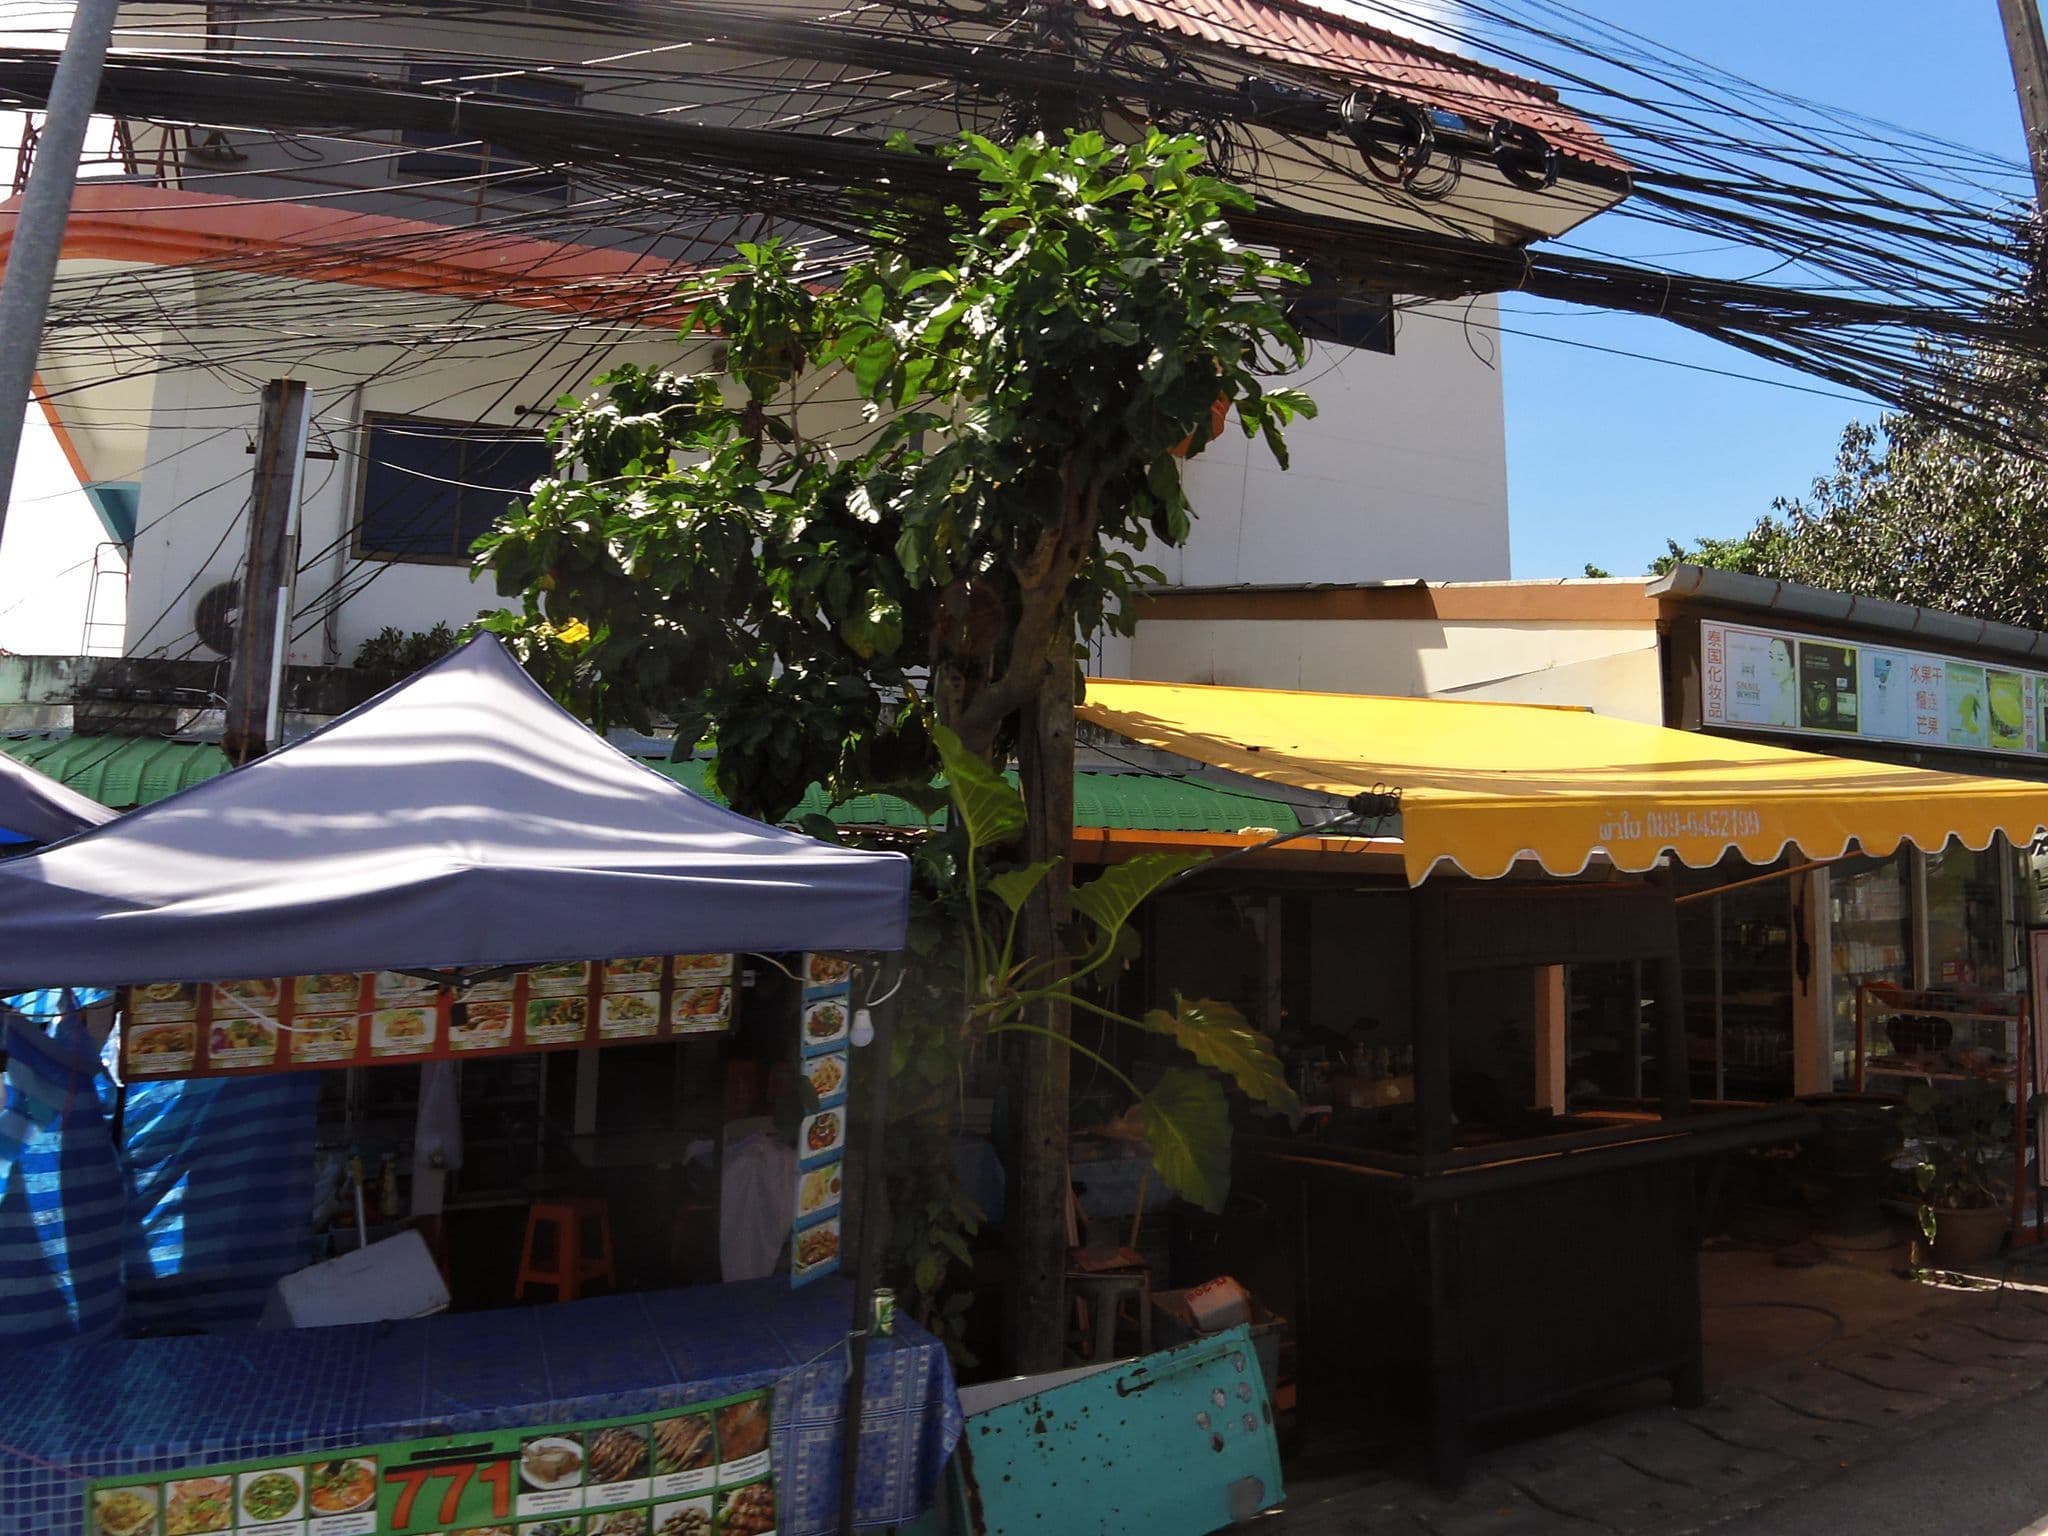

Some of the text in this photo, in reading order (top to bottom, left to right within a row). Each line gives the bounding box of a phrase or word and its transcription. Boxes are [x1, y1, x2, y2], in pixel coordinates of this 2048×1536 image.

[1707, 631, 1722, 718] 泰国化妆品
[1910, 664, 1943, 687] 水果干
[1917, 716, 1939, 735] 芒果
[384, 1459, 511, 1530] 771
